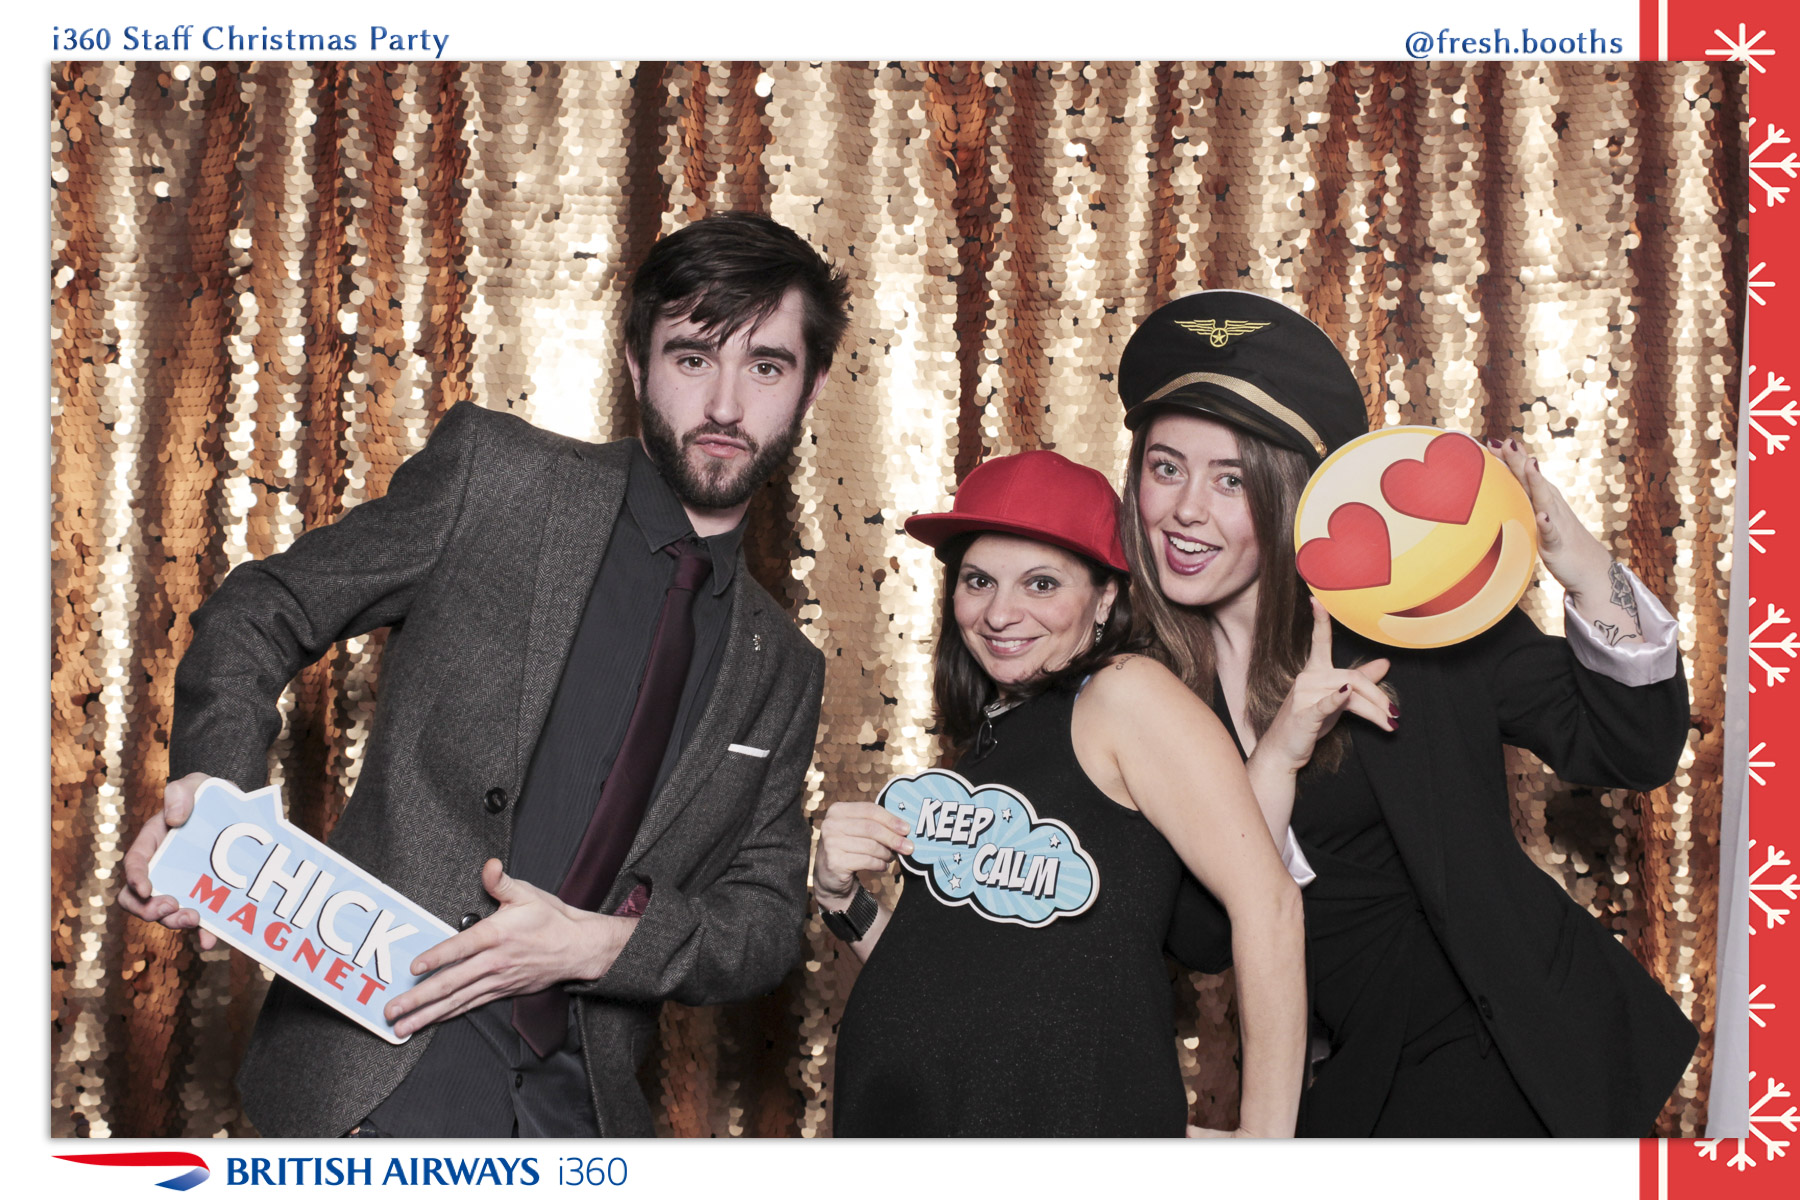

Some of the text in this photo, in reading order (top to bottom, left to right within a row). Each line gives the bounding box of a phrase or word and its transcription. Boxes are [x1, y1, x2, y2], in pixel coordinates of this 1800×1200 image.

[915, 798, 995, 848] KEEP
[210, 822, 419, 984] CHICK
[972, 843, 1060, 899] CALM
[189, 873, 386, 1006] MAGNET
